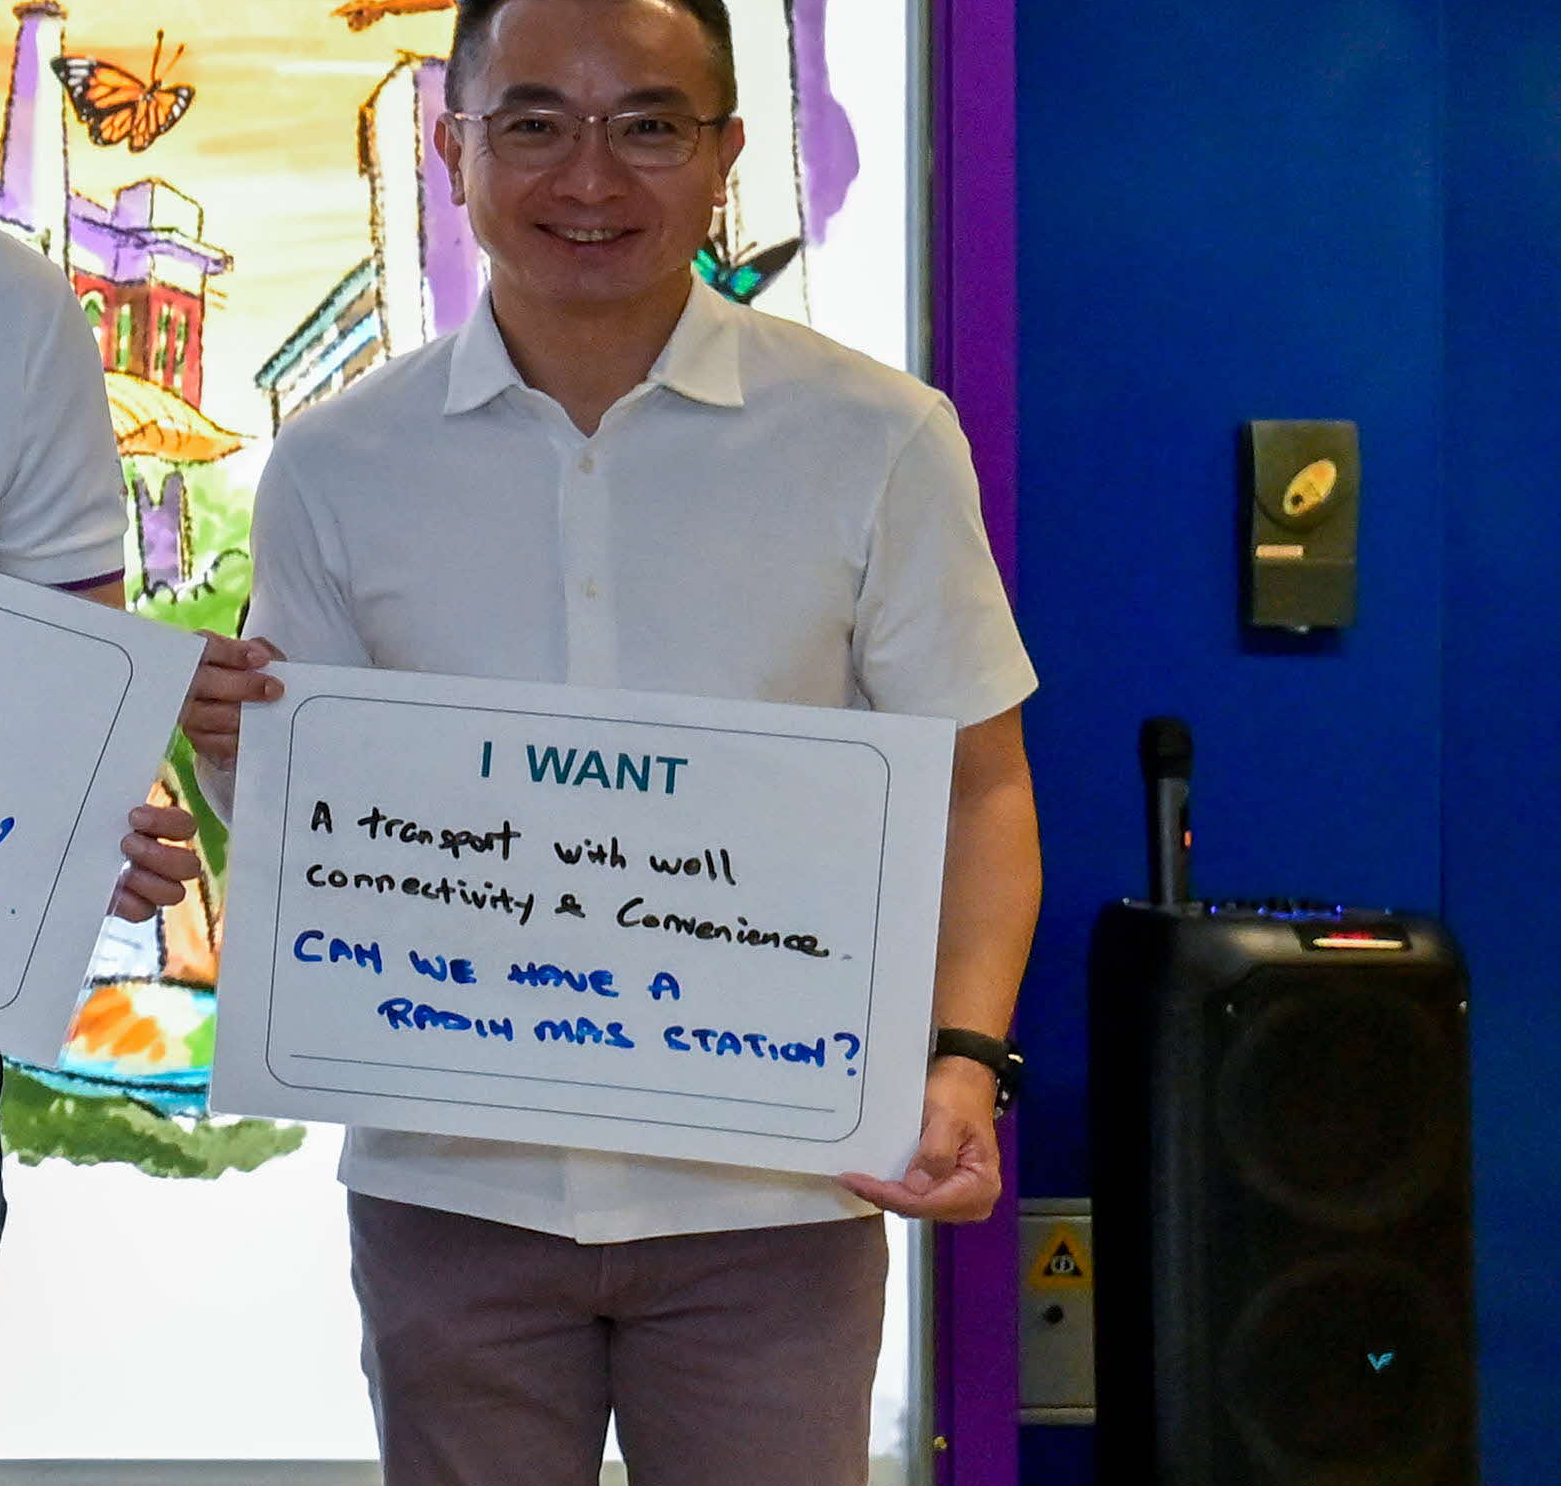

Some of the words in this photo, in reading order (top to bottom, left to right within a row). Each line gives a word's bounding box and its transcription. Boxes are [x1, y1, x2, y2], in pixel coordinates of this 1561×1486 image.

[480, 741, 493, 778] I
[526, 744, 689, 796] WANT
[310, 800, 333, 834] A
[358, 806, 522, 861] transport
[553, 837, 627, 870] with
[649, 848, 738, 886] well
[292, 929, 382, 975] CAN
[409, 950, 478, 986] WE
[509, 962, 620, 999] HAVE
[647, 971, 682, 1002] A
[377, 998, 514, 1042] RADIN
[533, 1016, 636, 1050] MAS
[663, 1025, 862, 1078] STATION?
